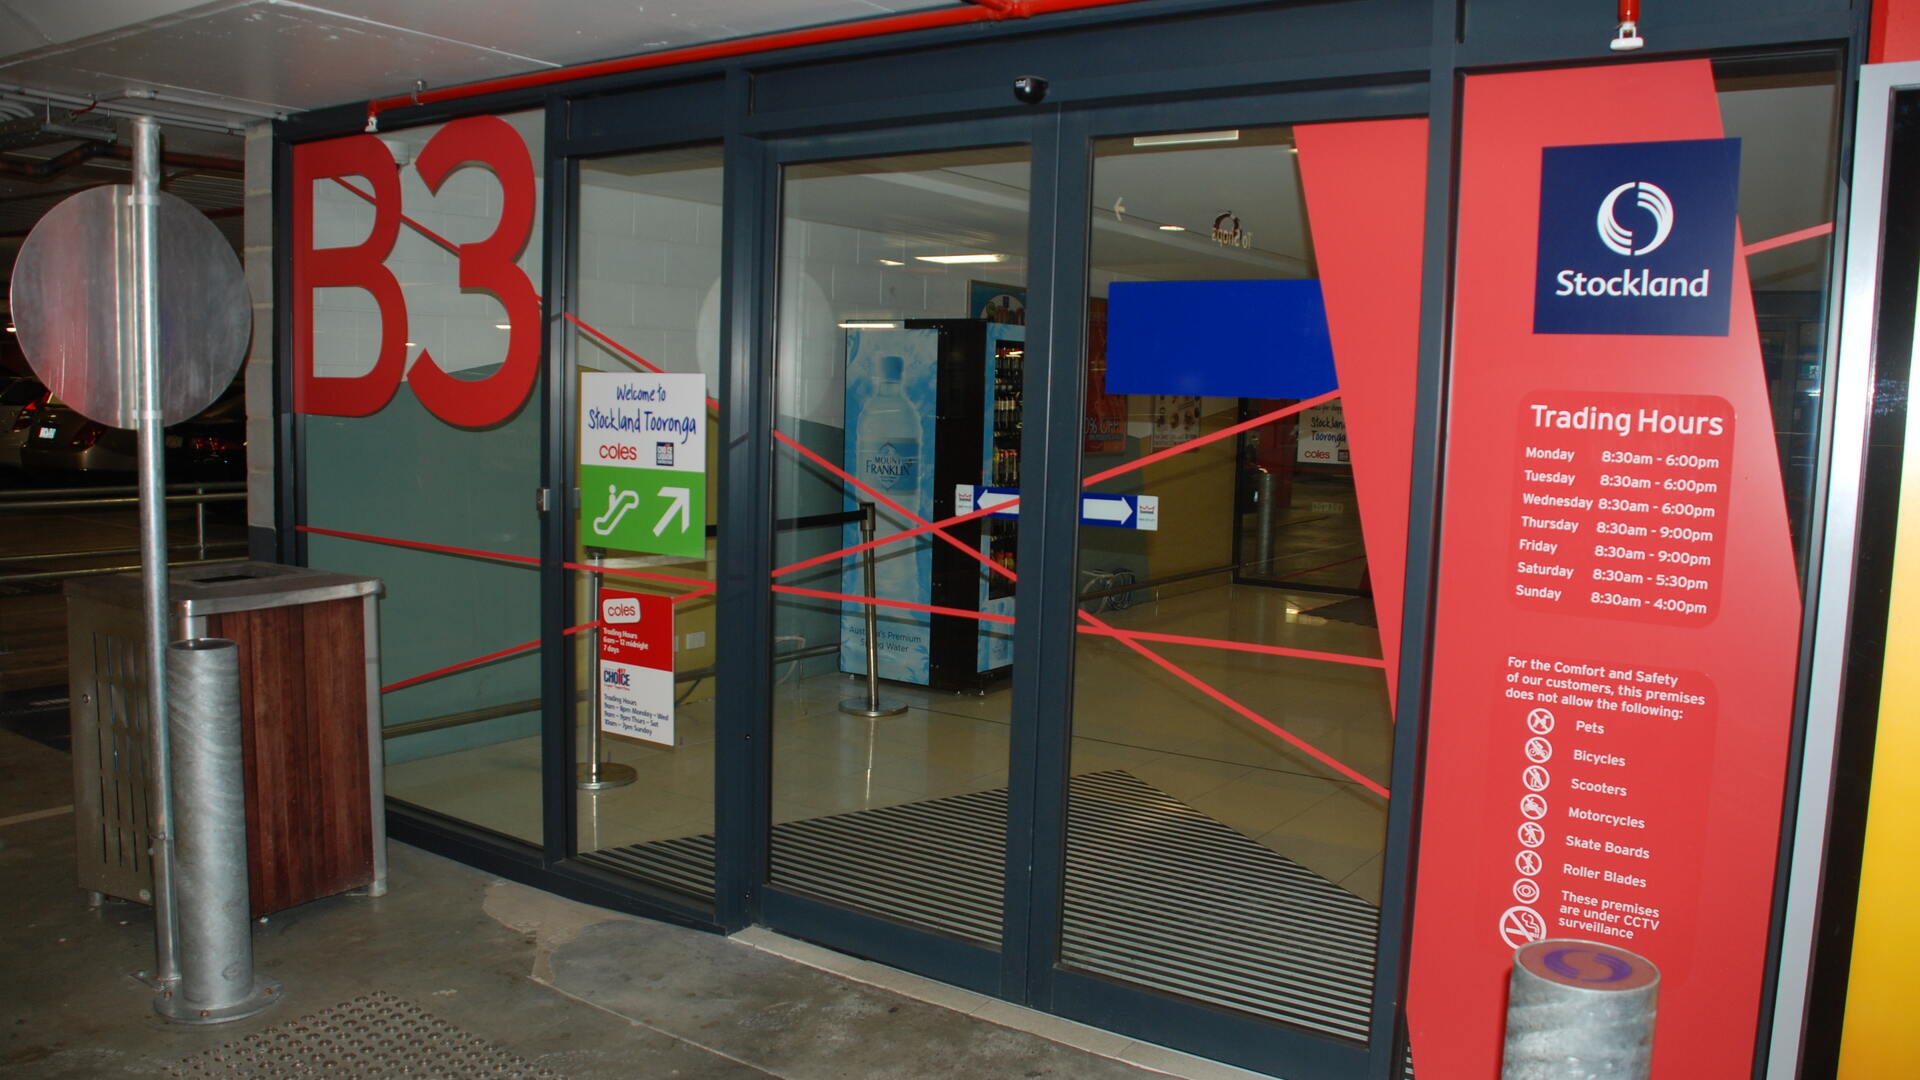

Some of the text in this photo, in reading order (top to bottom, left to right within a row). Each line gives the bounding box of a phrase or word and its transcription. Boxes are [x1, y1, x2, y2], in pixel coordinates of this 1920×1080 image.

[292, 115, 542, 427] B3
[1556, 269, 1710, 297] Stockland
[616, 384, 666, 403] Welcome to
[588, 408, 696, 444] Stockland Tooronga
[1530, 404, 1724, 436] Trading Hours
[599, 443, 637, 460] coles
[1304, 450, 1330, 459] coles
[1525, 447, 1575, 463] Monday
[1601, 451, 1653, 465] 8:30am
[1665, 454, 1719, 469] 6:00pm
[866, 460, 910, 476] FRANKLIN
[1524, 470, 1576, 486] Tuesday
[1600, 474, 1651, 489] 8:30am
[1664, 479, 1718, 494] 6:00pm
[1522, 493, 1593, 510] Wednesday
[1598, 498, 1649, 513] 8:30am
[1662, 503, 1715, 518] 6:00pm
[1521, 516, 1579, 533] Thursday
[1596, 522, 1648, 537] 8:30am
[1660, 527, 1713, 542] 9:00pm
[1519, 539, 1558, 555] Friday
[1595, 545, 1645, 560] 8:30am
[1658, 551, 1711, 567] 9:00pm
[1517, 562, 1574, 579] Saturday
[1592, 569, 1643, 584] 8:30am
[1656, 574, 1708, 591] 5:30pm
[607, 604, 636, 617] coles
[1515, 585, 1562, 601] Sunday
[1591, 592, 1641, 608] 8:30am
[1653, 598, 1707, 614] 4:00pm
[603, 627, 638, 639] Trading Hours
[888, 631, 921, 643] Premium
[608, 645, 620, 654] days
[626, 641, 649, 650] midnight
[887, 643, 909, 653] Water
[1508, 656, 1679, 687] For the Comfort and Safety
[604, 693, 621, 704] Trading
[1506, 672, 1706, 706] of our customers, this premises
[632, 708, 652, 718] Monday
[1505, 688, 1684, 721] does not allow the following:
[632, 716, 645, 724] Thurs
[634, 725, 652, 736] Sunday
[1576, 720, 1605, 734] Pets
[1573, 749, 1626, 767] Bicycles
[1571, 778, 1628, 796] Scooters
[1568, 807, 1646, 829] Motorcycles
[1566, 835, 1650, 859] Skate Boards
[1563, 864, 1647, 888] Roller Blades
[1561, 890, 1660, 918] These premises
[1558, 917, 1634, 939] surveillance
[1560, 904, 1660, 931] are under CCTV
